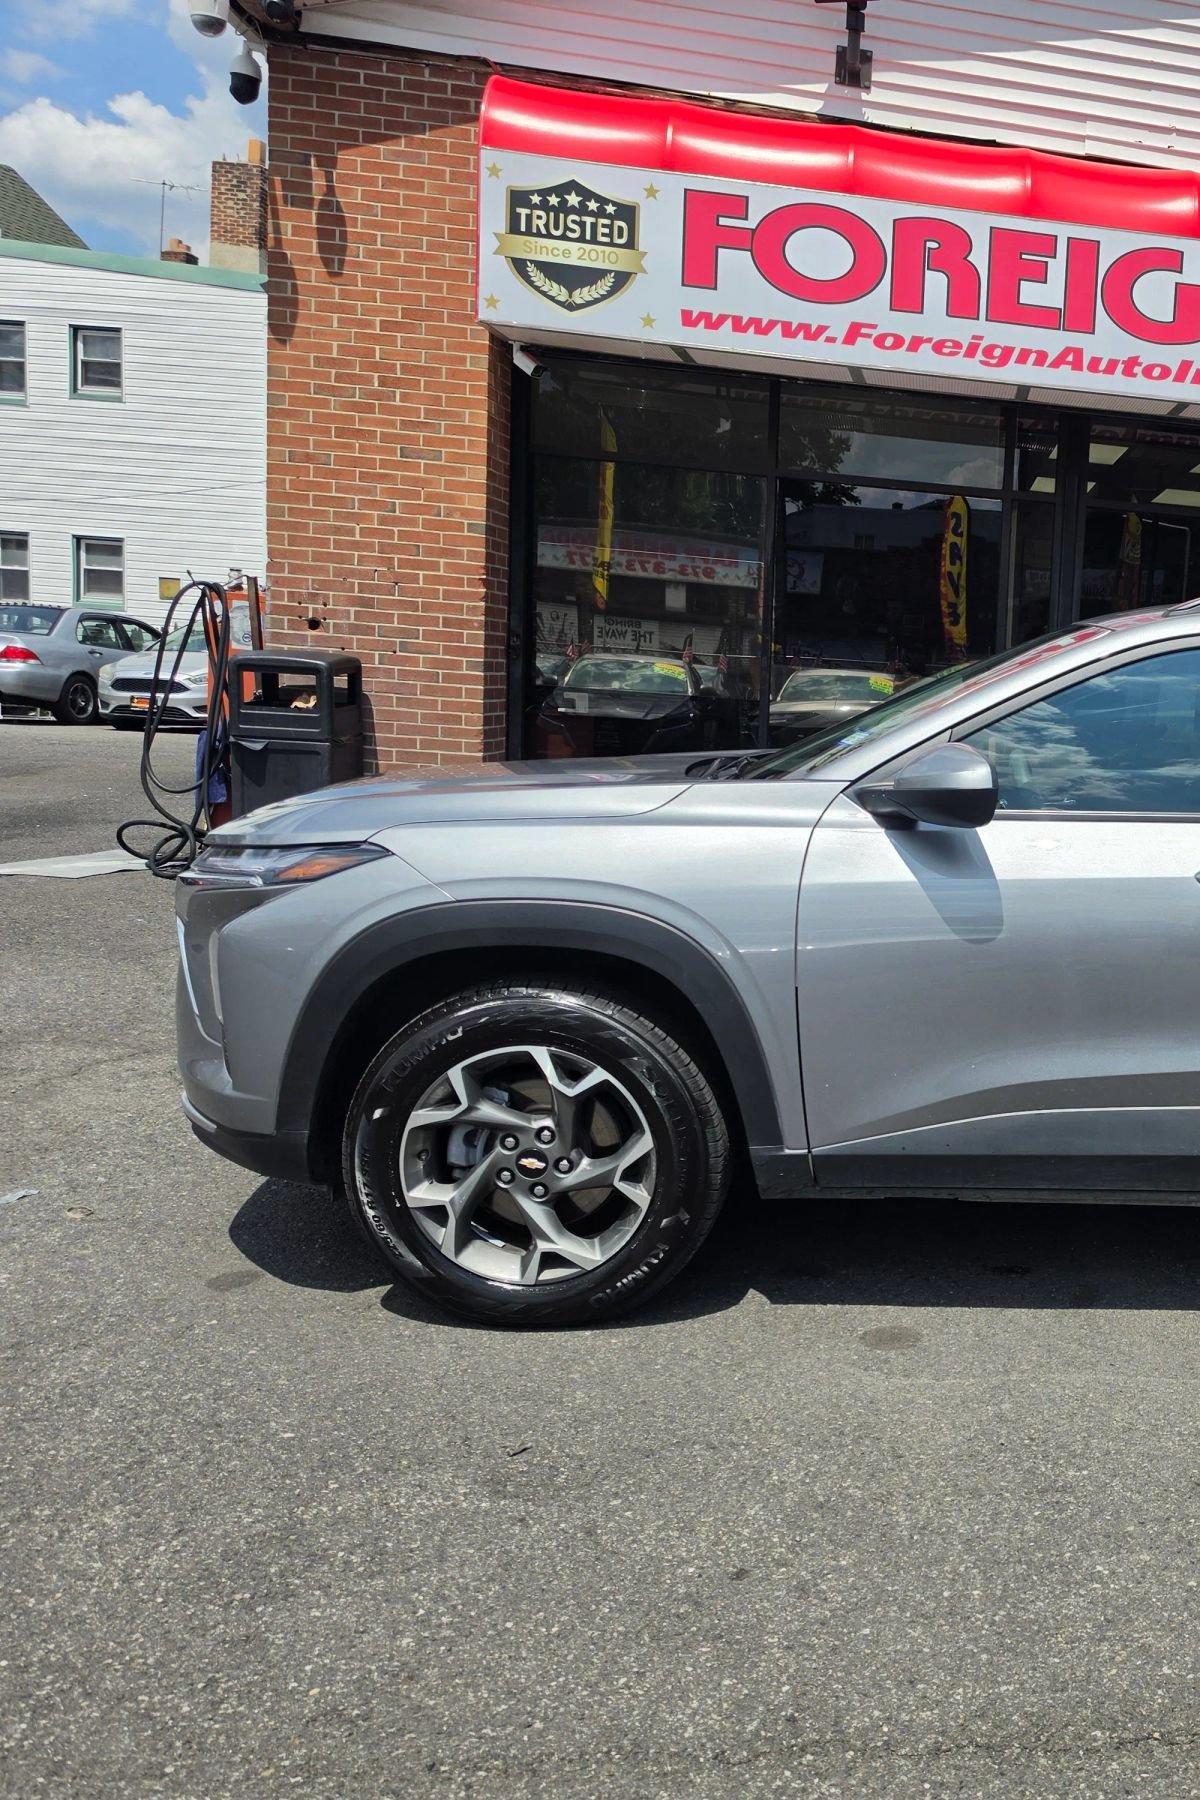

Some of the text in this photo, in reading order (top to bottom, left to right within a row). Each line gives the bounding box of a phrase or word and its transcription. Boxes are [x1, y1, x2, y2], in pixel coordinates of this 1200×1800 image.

[515, 207, 629, 245] TRUSTED
[523, 240, 619, 265] Since 2010
